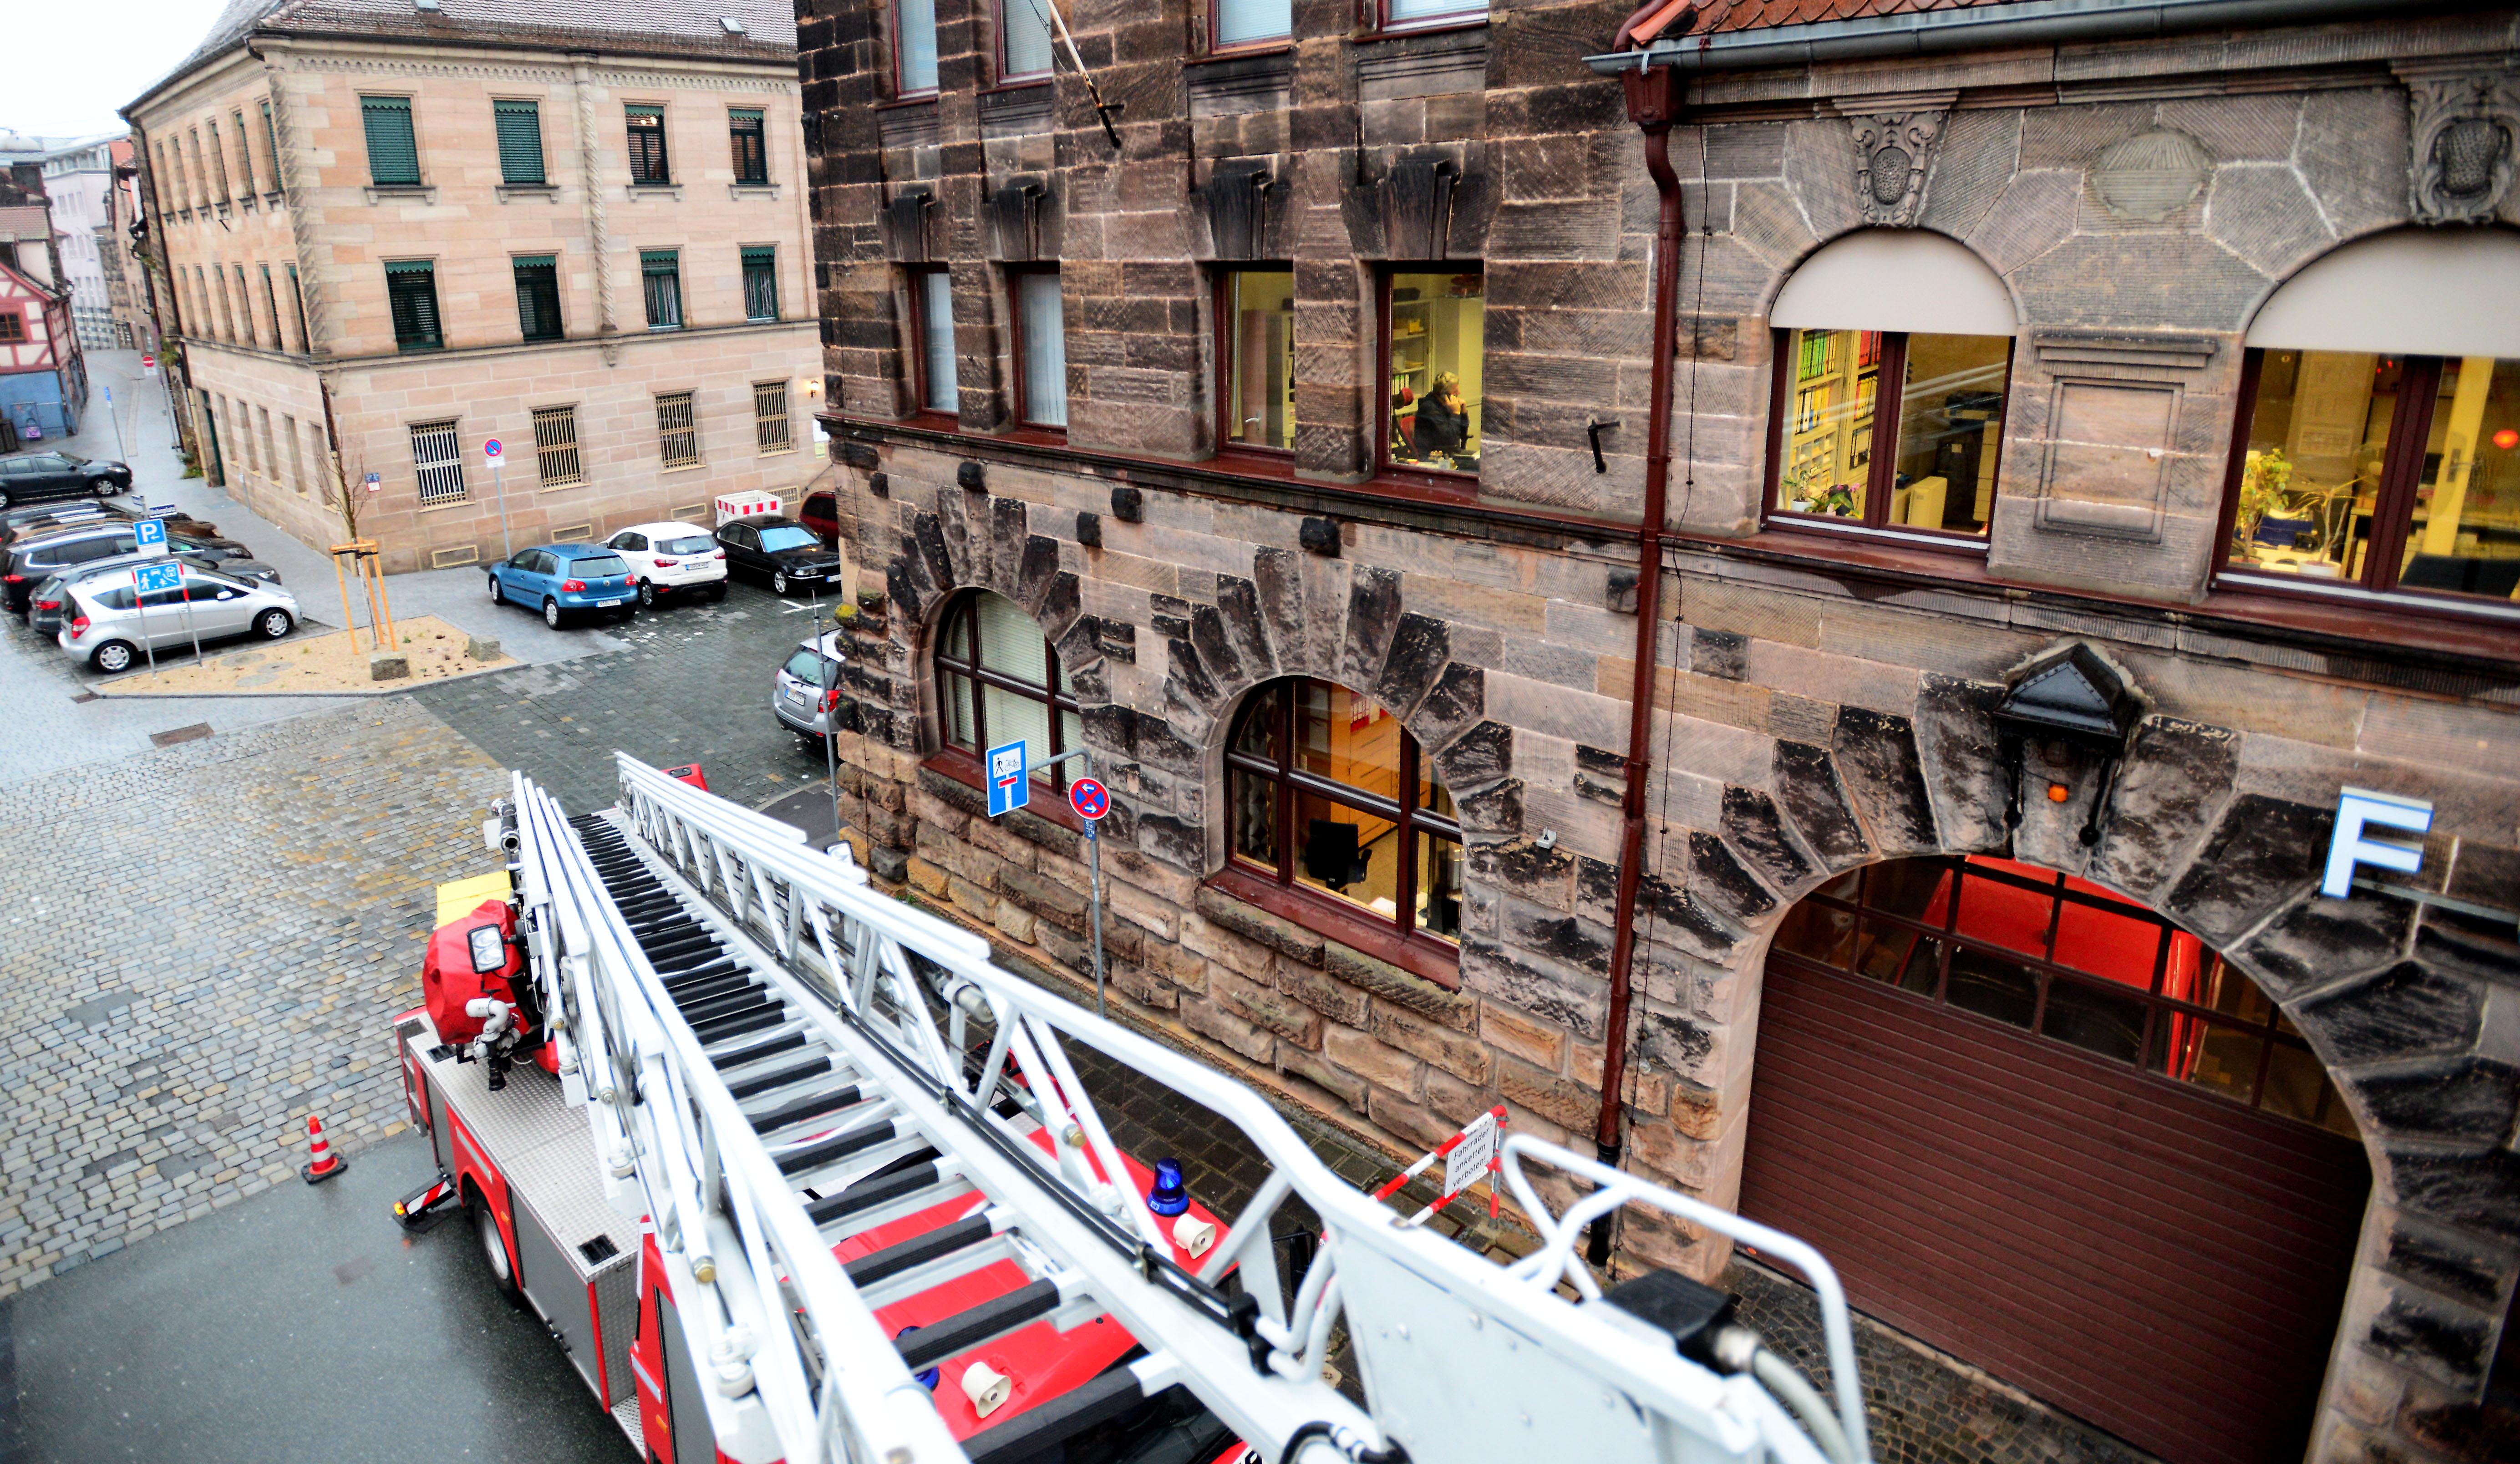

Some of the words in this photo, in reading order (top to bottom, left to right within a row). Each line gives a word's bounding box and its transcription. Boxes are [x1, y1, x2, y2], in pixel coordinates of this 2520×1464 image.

[140, 523, 157, 542] P
[2321, 788, 2434, 899] F
[1454, 1128, 1489, 1161] Fahrräder
[1455, 1144, 1486, 1173] anketten
[1453, 1154, 1486, 1187] verboten!
